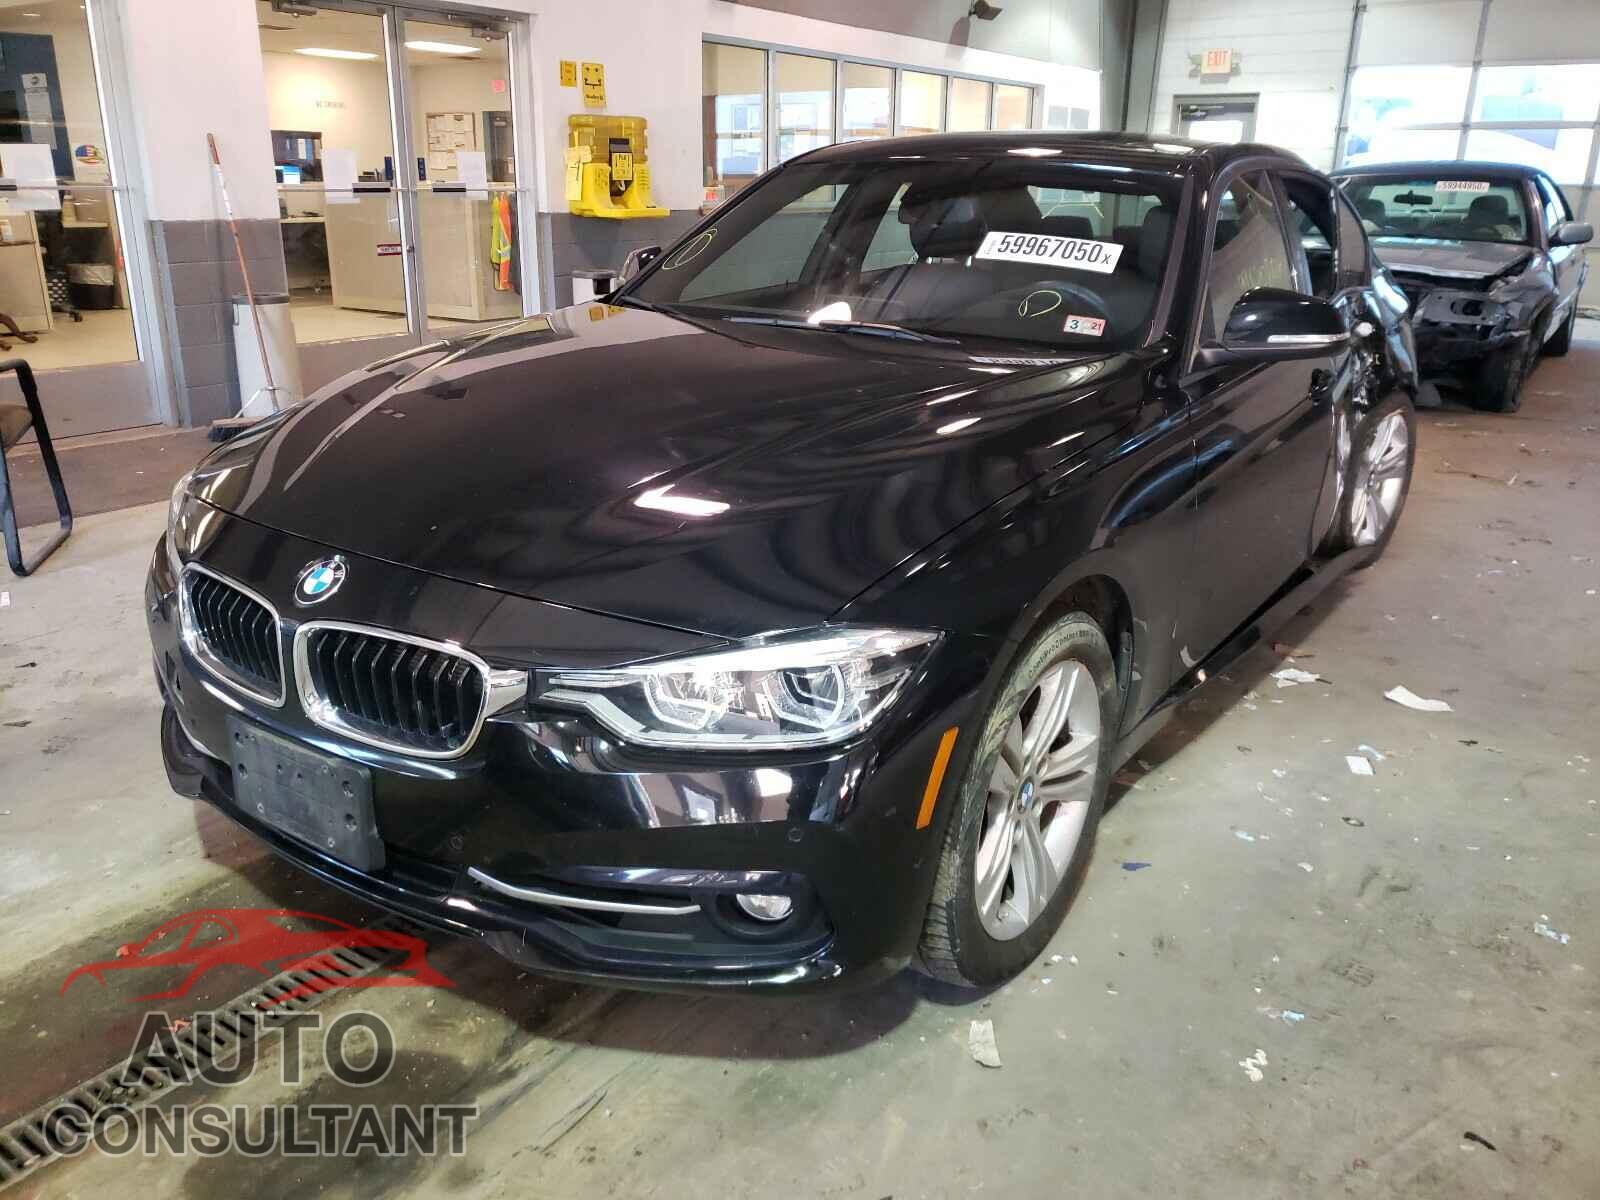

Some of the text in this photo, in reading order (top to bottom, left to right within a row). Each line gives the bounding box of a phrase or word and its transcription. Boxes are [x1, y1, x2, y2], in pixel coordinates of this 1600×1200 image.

[1207, 50, 1229, 65] EXIT
[1069, 319, 1102, 331] 3 21
